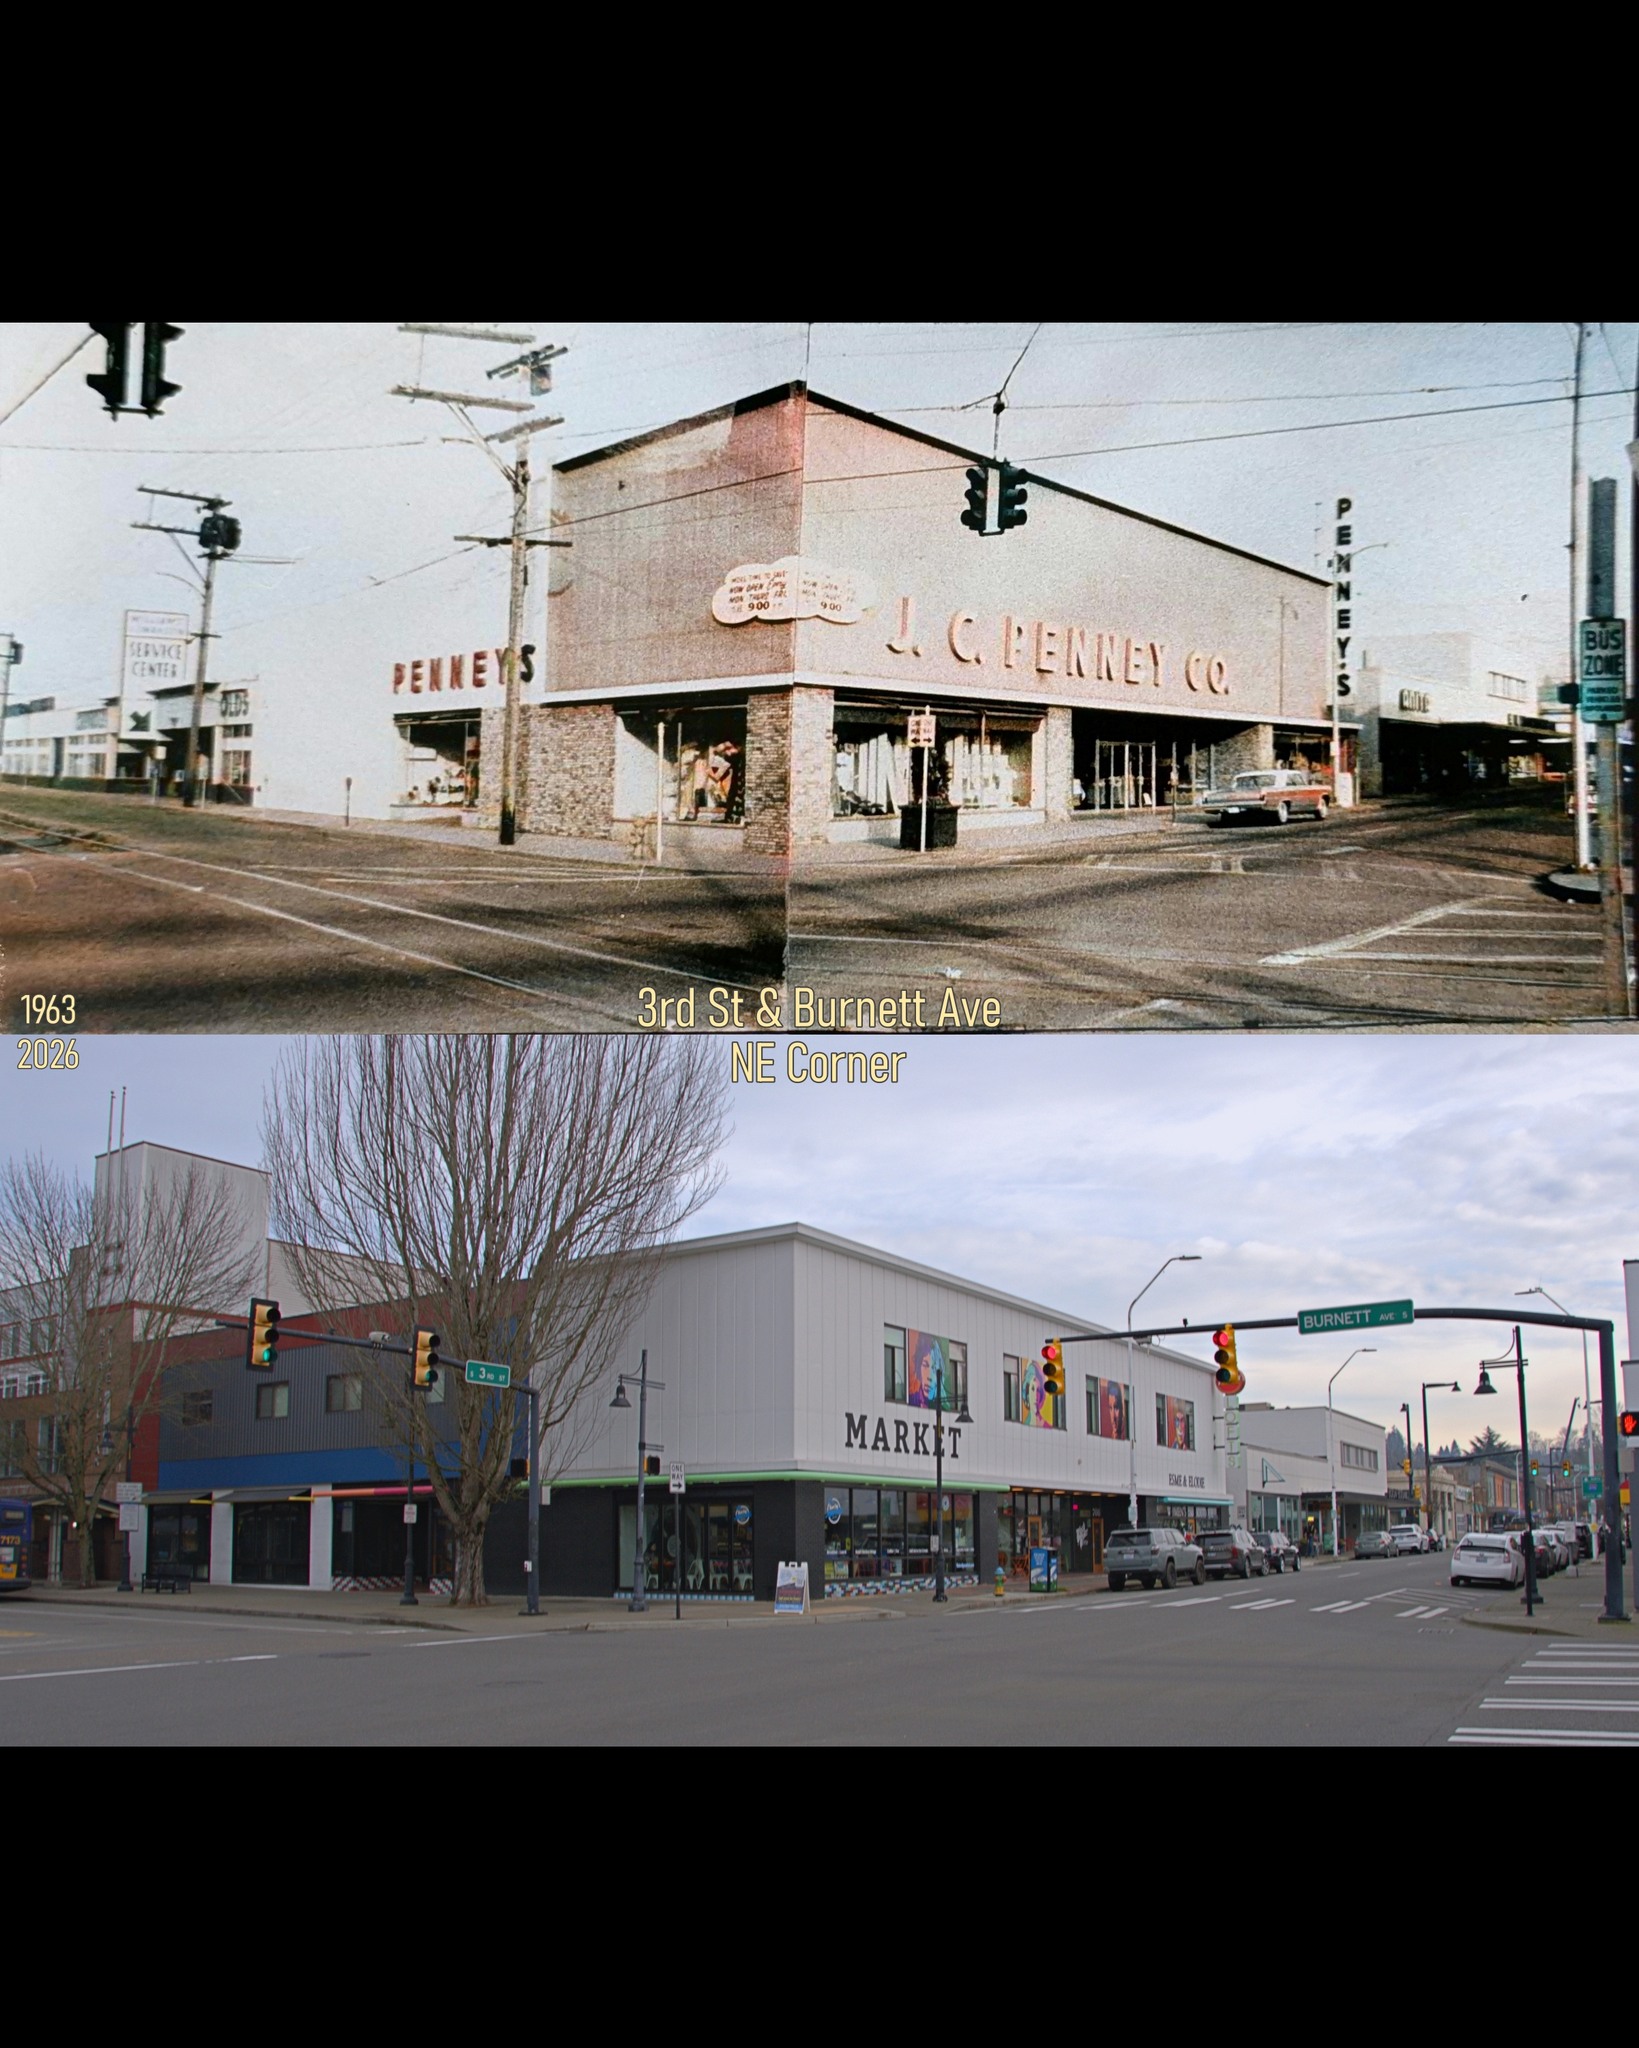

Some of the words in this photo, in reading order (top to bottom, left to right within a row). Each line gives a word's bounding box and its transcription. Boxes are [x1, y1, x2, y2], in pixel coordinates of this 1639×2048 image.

[729, 586, 744, 594] NOW
[746, 583, 764, 592] OPEN
[1336, 498, 1352, 696] PENNEY'S
[886, 597, 921, 657] J.
[947, 609, 981, 665] C.
[1003, 615, 1166, 689] PENNEY
[1184, 649, 1229, 695] CO.
[1584, 629, 1622, 650] BUS
[130, 641, 182, 660] SERVICE
[132, 661, 177, 678] CENTER
[1584, 654, 1623, 675] ZONE
[1303, 1309, 1372, 1329] BURNETT
[1380, 1312, 1395, 1321] AVE
[1402, 1311, 1408, 1319] S
[470, 1370, 474, 1378] S
[479, 1367, 494, 1380] 3RD
[845, 1412, 961, 1459] MARKET
[671, 1464, 683, 1472] ONE
[671, 1473, 684, 1481] WAY
[1168, 1473, 1182, 1487] ESME
[1183, 1474, 1188, 1487] &
[0, 1535, 21, 1545] 7173
